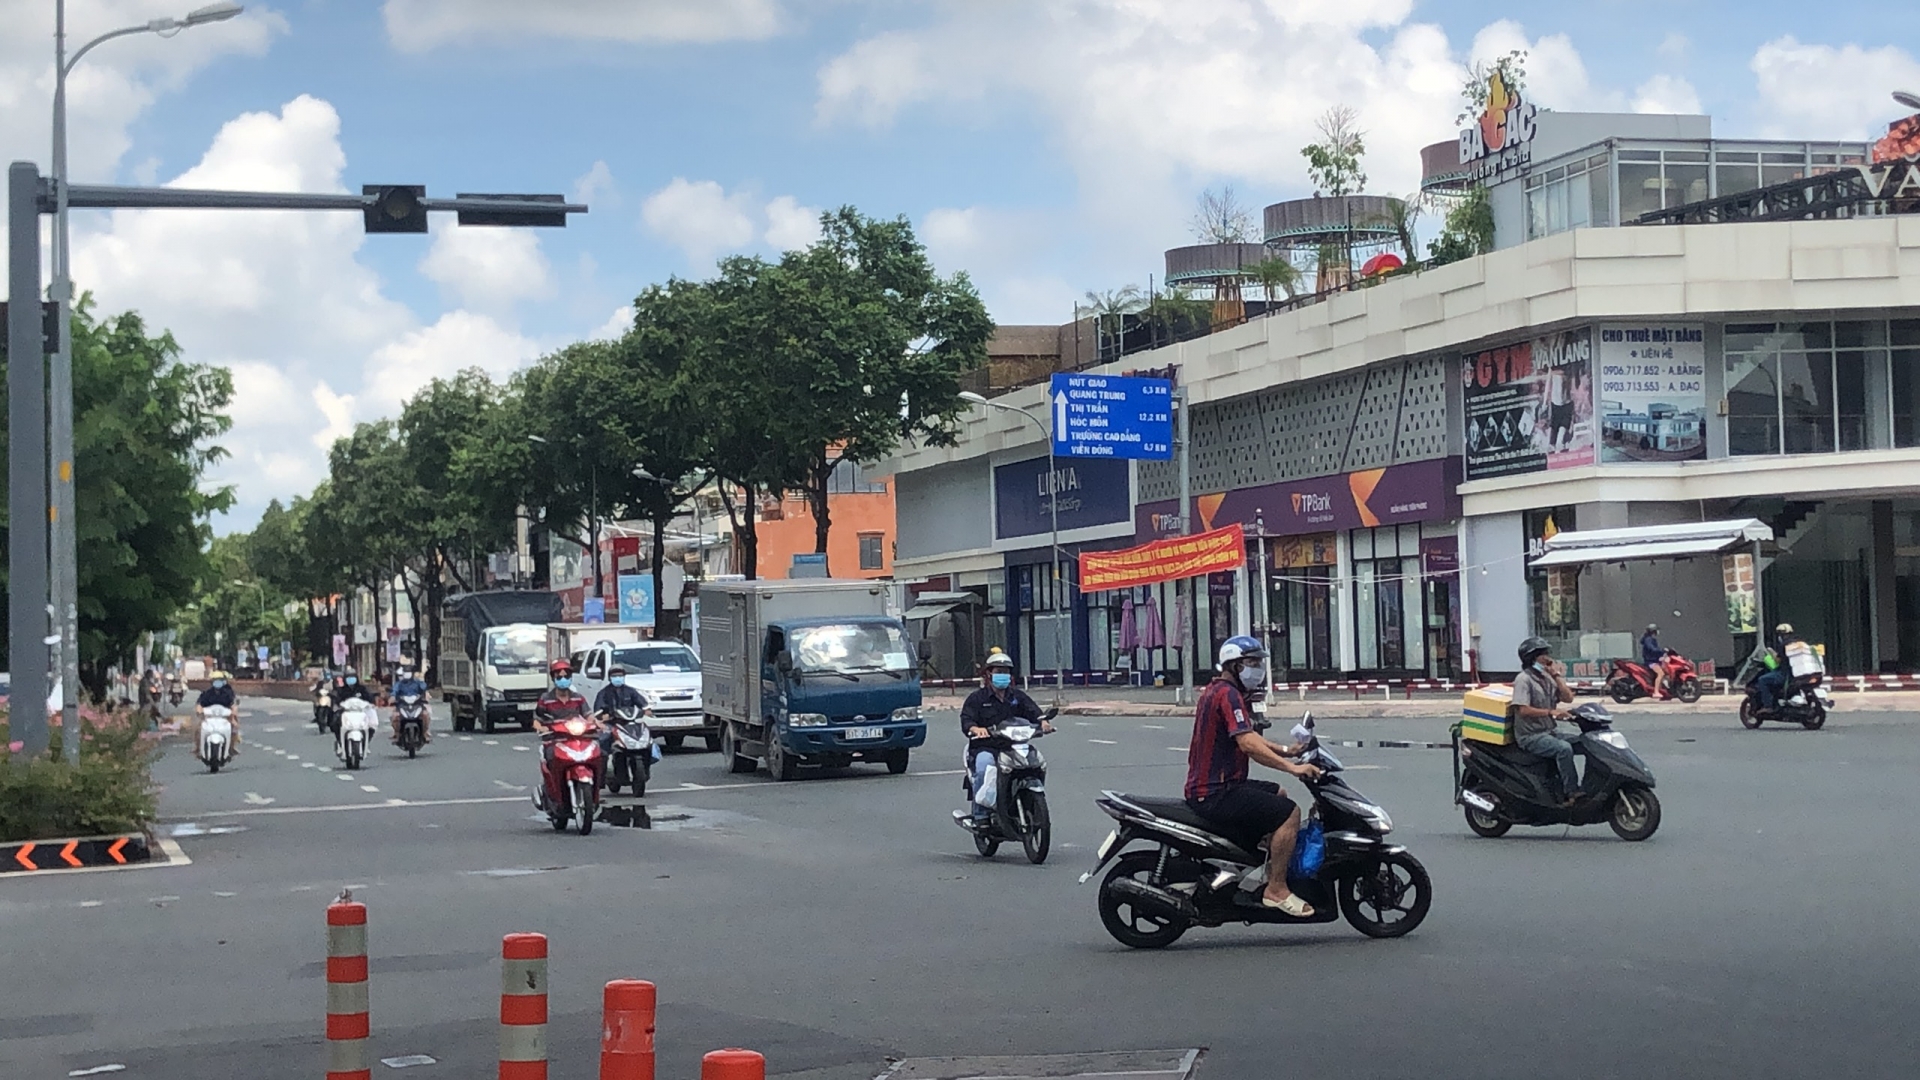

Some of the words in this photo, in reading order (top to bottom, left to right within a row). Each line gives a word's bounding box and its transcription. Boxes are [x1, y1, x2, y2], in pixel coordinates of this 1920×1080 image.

[1602, 329, 1623, 342] CHO
[1625, 328, 1650, 342] THUÊ
[1652, 327, 1674, 345] MẶT
[1641, 347, 1659, 358] LIÊN
[1476, 344, 1533, 388] GYM
[1558, 339, 1590, 365] LANG
[1088, 378, 1107, 388] GIAO
[1069, 390, 1098, 399] QUANG
[1099, 391, 1126, 400] TRUNG
[1070, 404, 1084, 415] THỊ
[1070, 417, 1087, 427] HÓC
[1090, 416, 1108, 427] MÔN
[1104, 433, 1120, 441] CAO
[1092, 445, 1113, 455] ĐÔNG
[1301, 491, 1331, 513] TPBank
